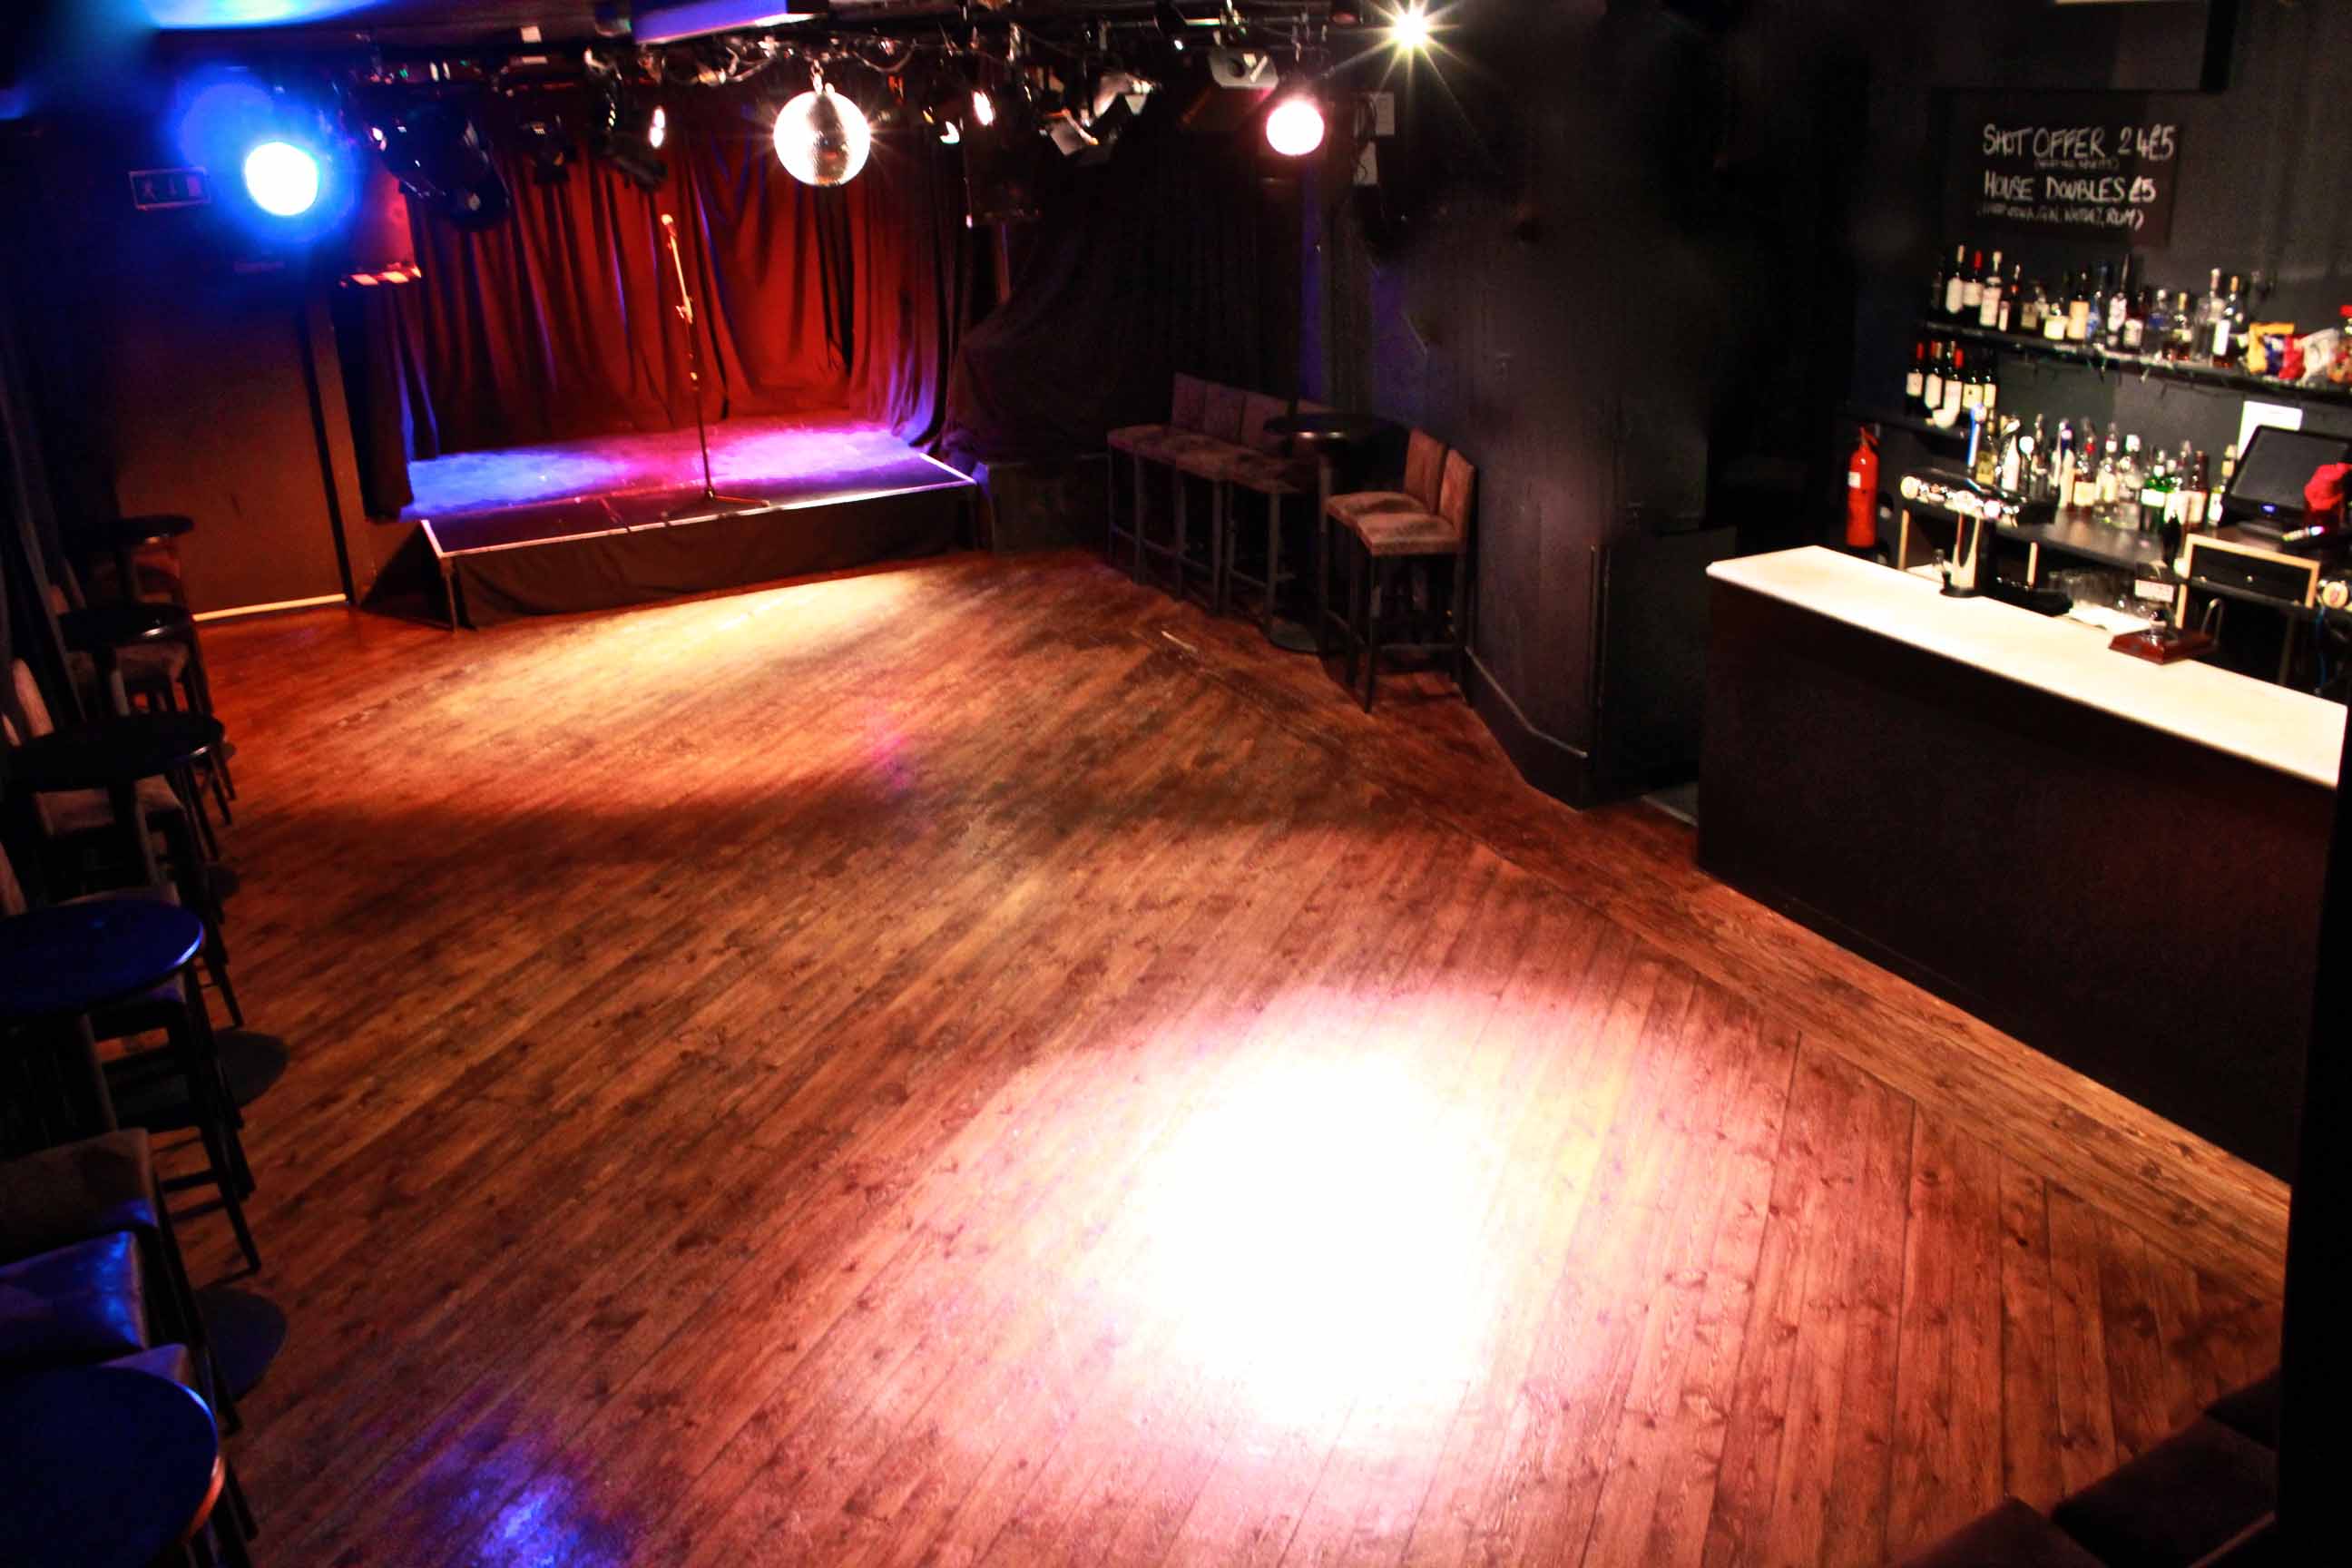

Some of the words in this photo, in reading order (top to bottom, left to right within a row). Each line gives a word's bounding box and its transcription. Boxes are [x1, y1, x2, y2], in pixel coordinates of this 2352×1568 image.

[1983, 123, 2033, 157] SHOT
[2034, 126, 2105, 160] OFFER
[1984, 169, 2034, 201] HOUSE
[2046, 176, 2126, 203] DOUBLES
[2128, 175, 2157, 203] £5
